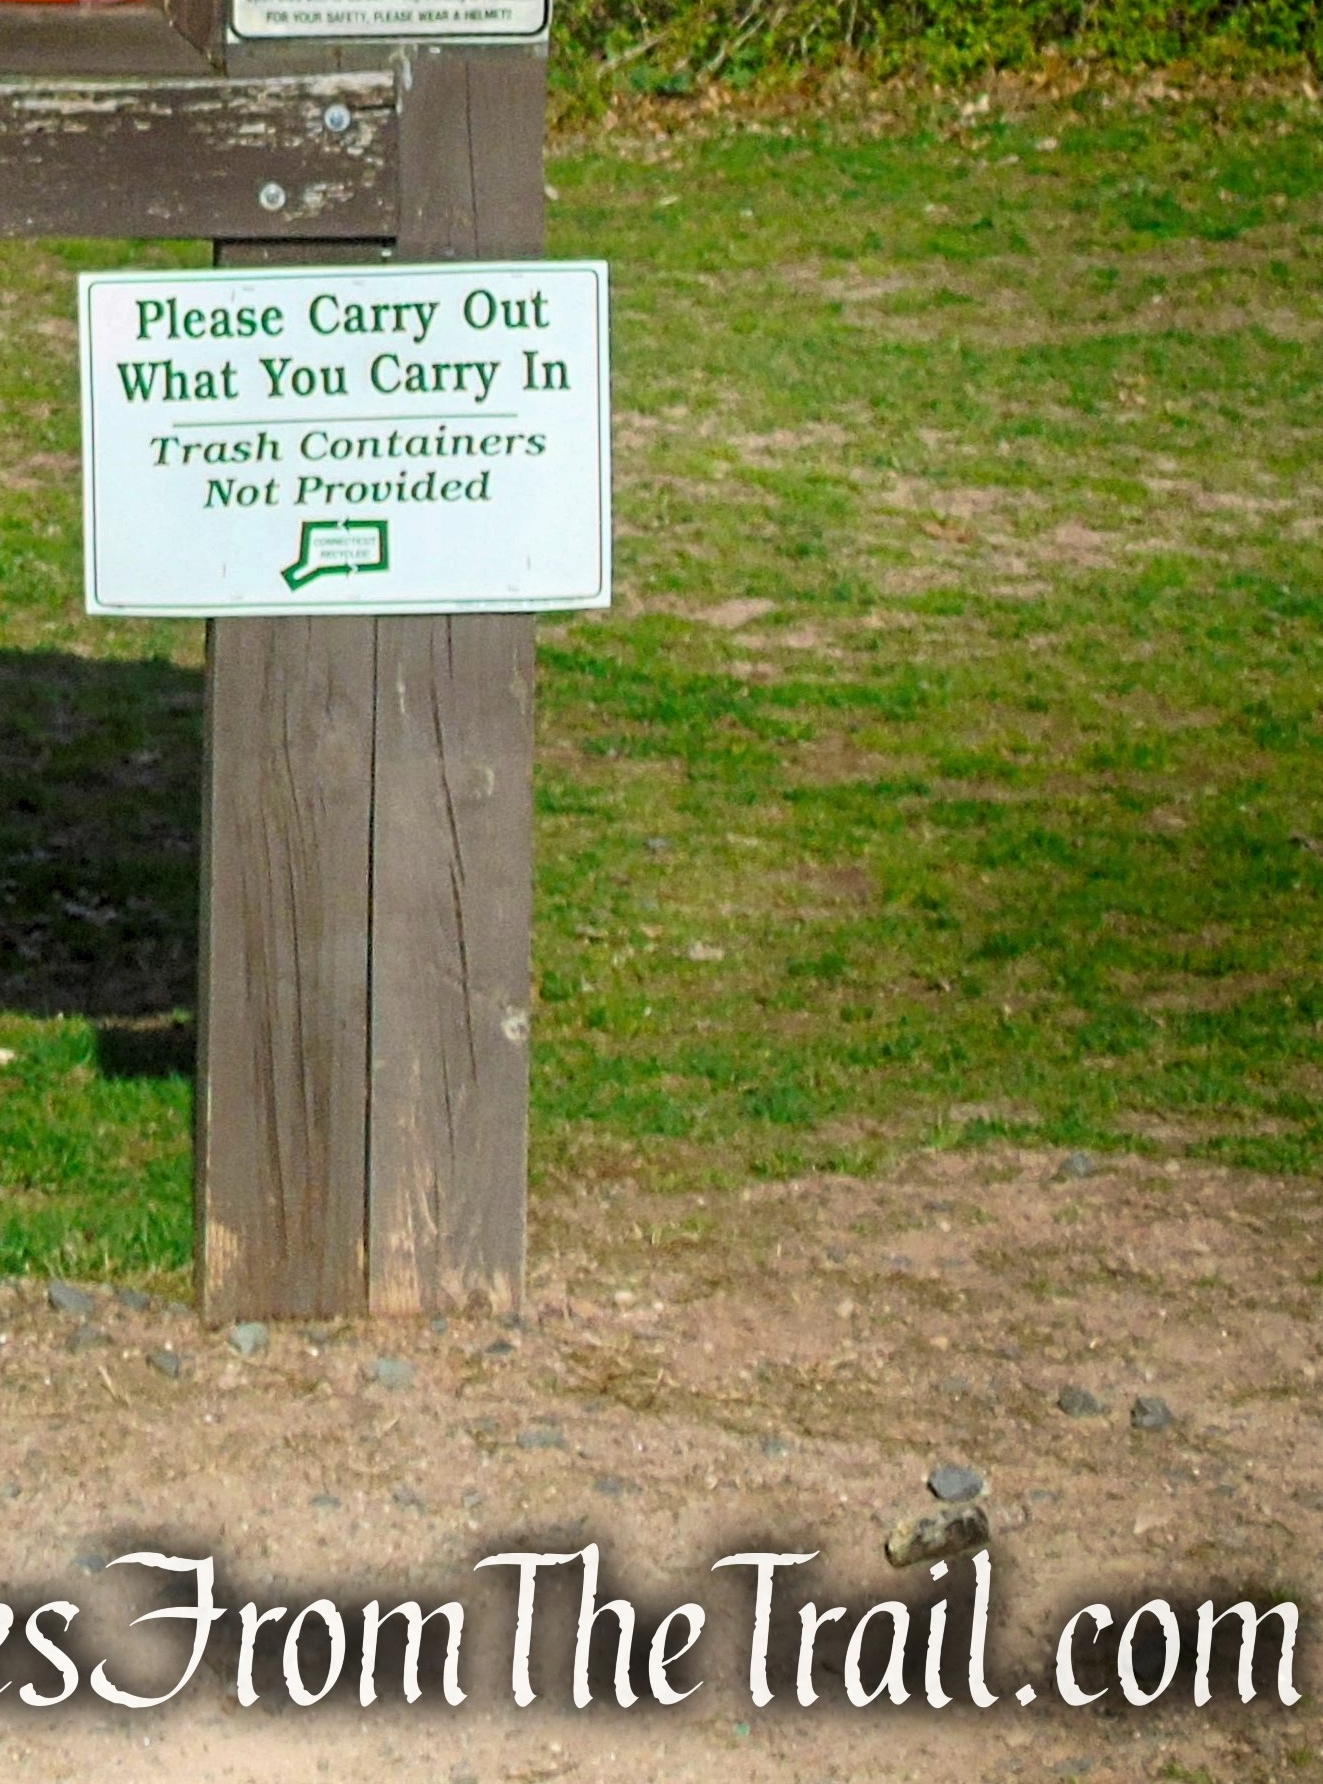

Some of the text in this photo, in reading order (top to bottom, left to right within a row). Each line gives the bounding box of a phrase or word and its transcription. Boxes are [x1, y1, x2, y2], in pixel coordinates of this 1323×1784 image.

[267, 11, 287, 23] FOR
[294, 11, 321, 23] YOUR
[374, 10, 413, 22] PLEASE
[419, 10, 449, 21] WEAR
[454, 10, 459, 21] A
[136, 289, 549, 342] Please Carry Out
[116, 350, 570, 402] What You Carry In
[150, 424, 547, 467] Trash Containers
[203, 471, 491, 509] Not Provided
